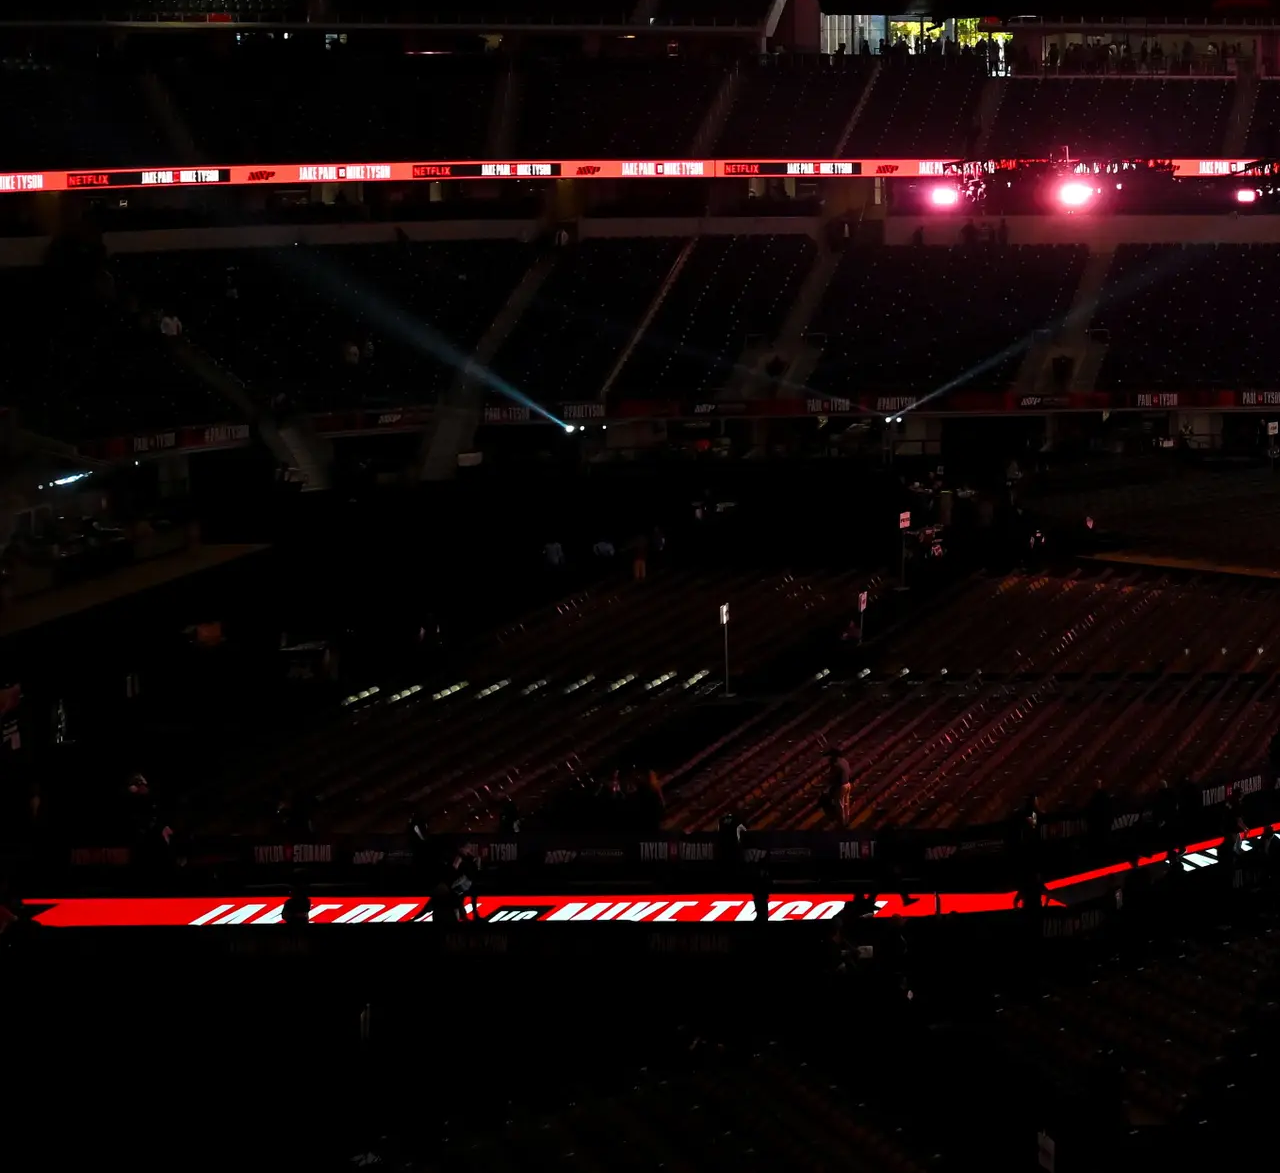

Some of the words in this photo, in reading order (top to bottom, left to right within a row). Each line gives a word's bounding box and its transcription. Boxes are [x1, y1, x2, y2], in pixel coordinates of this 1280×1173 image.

[300, 167, 317, 180] JAKE
[319, 166, 337, 179] PAUL
[347, 166, 364, 179] MIKE
[366, 166, 390, 178] TYSON
[414, 167, 451, 176] NETFLIX
[482, 165, 496, 175] JAKE
[497, 165, 510, 175] PAUL
[639, 163, 655, 175] PAUL
[725, 164, 759, 173] NETFLIX
[17, 175, 42, 189] TYSON
[69, 175, 108, 185] NETFLIX
[142, 171, 157, 184] JAKE
[158, 171, 172, 183] PAUL
[180, 170, 197, 183] MIKE
[198, 170, 219, 182] TYSON
[807, 399, 822, 412] PAUL
[830, 398, 850, 411] TYSON
[877, 397, 916, 410] #PAULTYSON
[1138, 394, 1152, 406] PAUL
[1159, 394, 1178, 406] TYSON
[1243, 392, 1256, 404] PAUL
[484, 407, 501, 421] PAUL
[564, 404, 605, 418] #PAULTYSON
[1203, 785, 1226, 807] TAYLOR
[254, 845, 283, 864] TAYLOR
[489, 843, 518, 862] TYSON
[640, 842, 668, 863] TAYLOR
[839, 840, 859, 860] PAUL
